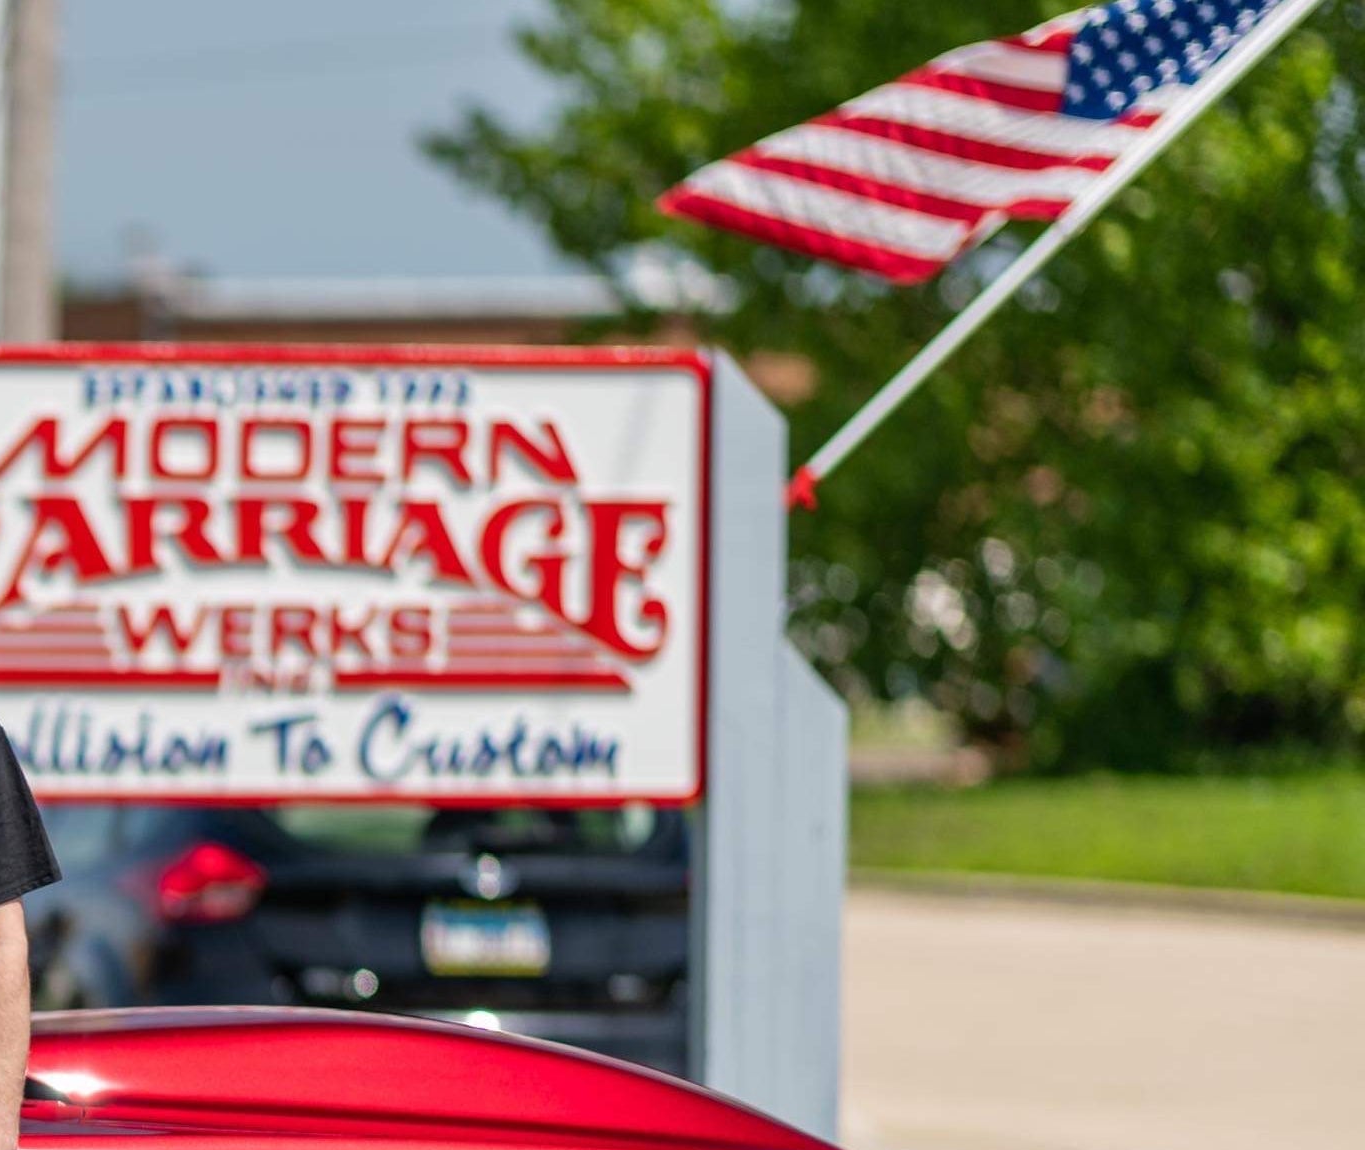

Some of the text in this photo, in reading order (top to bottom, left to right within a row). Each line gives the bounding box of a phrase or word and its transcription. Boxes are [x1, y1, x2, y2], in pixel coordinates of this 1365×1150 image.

[115, 603, 434, 657] WERKS
[9, 694, 619, 783] llision To Custom
